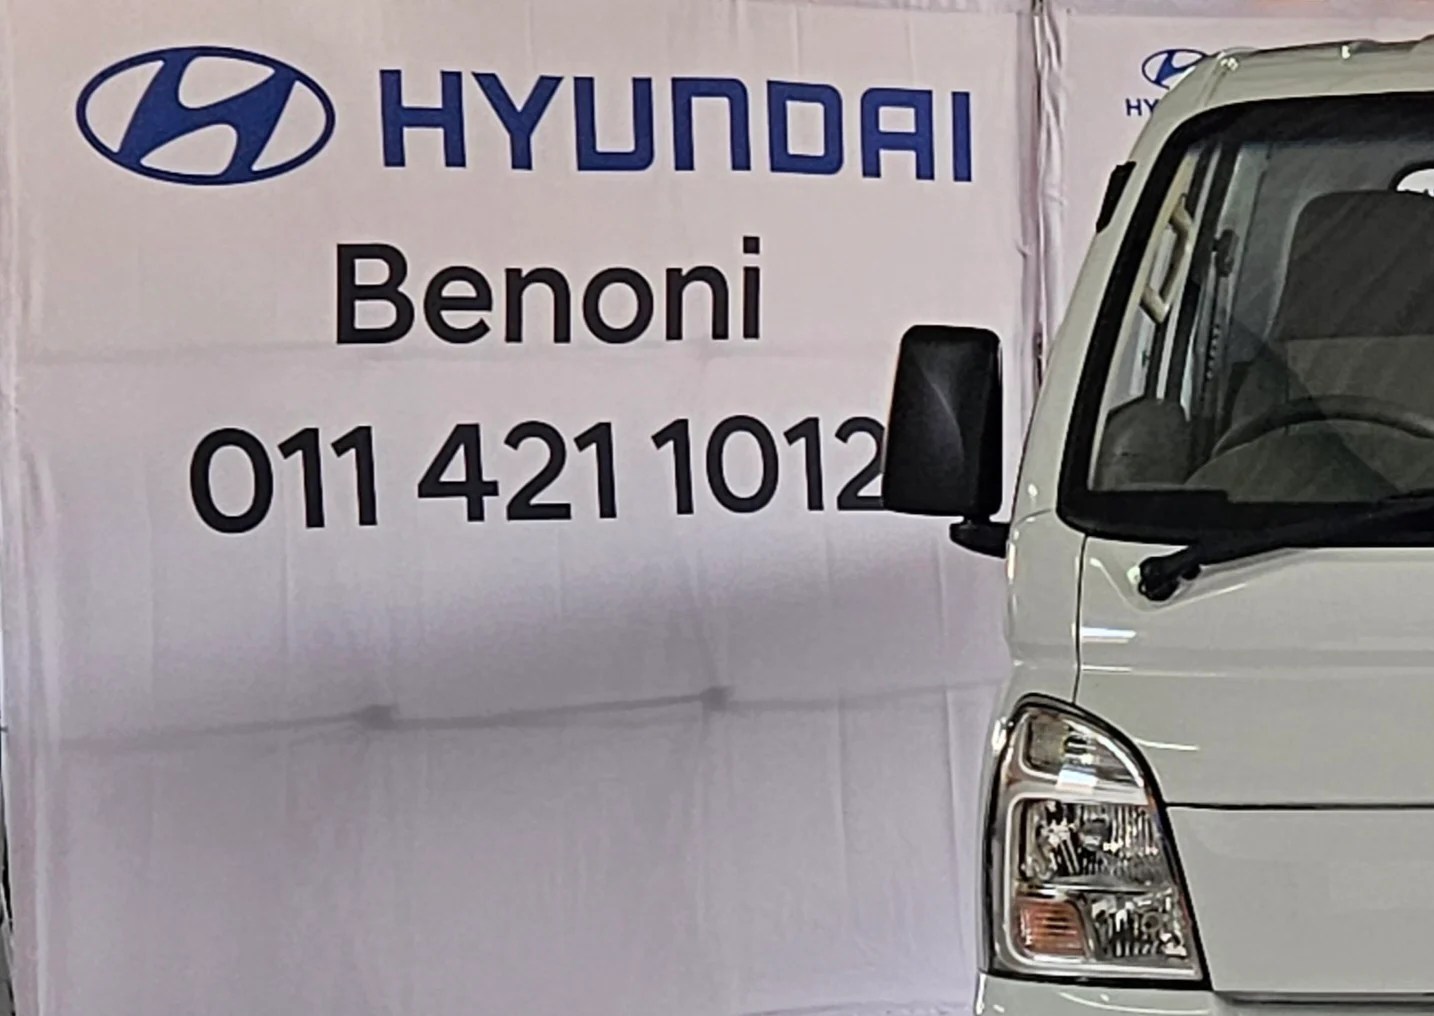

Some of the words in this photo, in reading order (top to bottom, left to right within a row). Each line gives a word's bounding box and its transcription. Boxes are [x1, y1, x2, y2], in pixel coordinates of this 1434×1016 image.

[378, 68, 972, 183] HYUNDAI
[335, 235, 761, 345] Benoni
[189, 425, 378, 534] 011
[417, 420, 618, 523] 421
[652, 413, 886, 515] 1012
